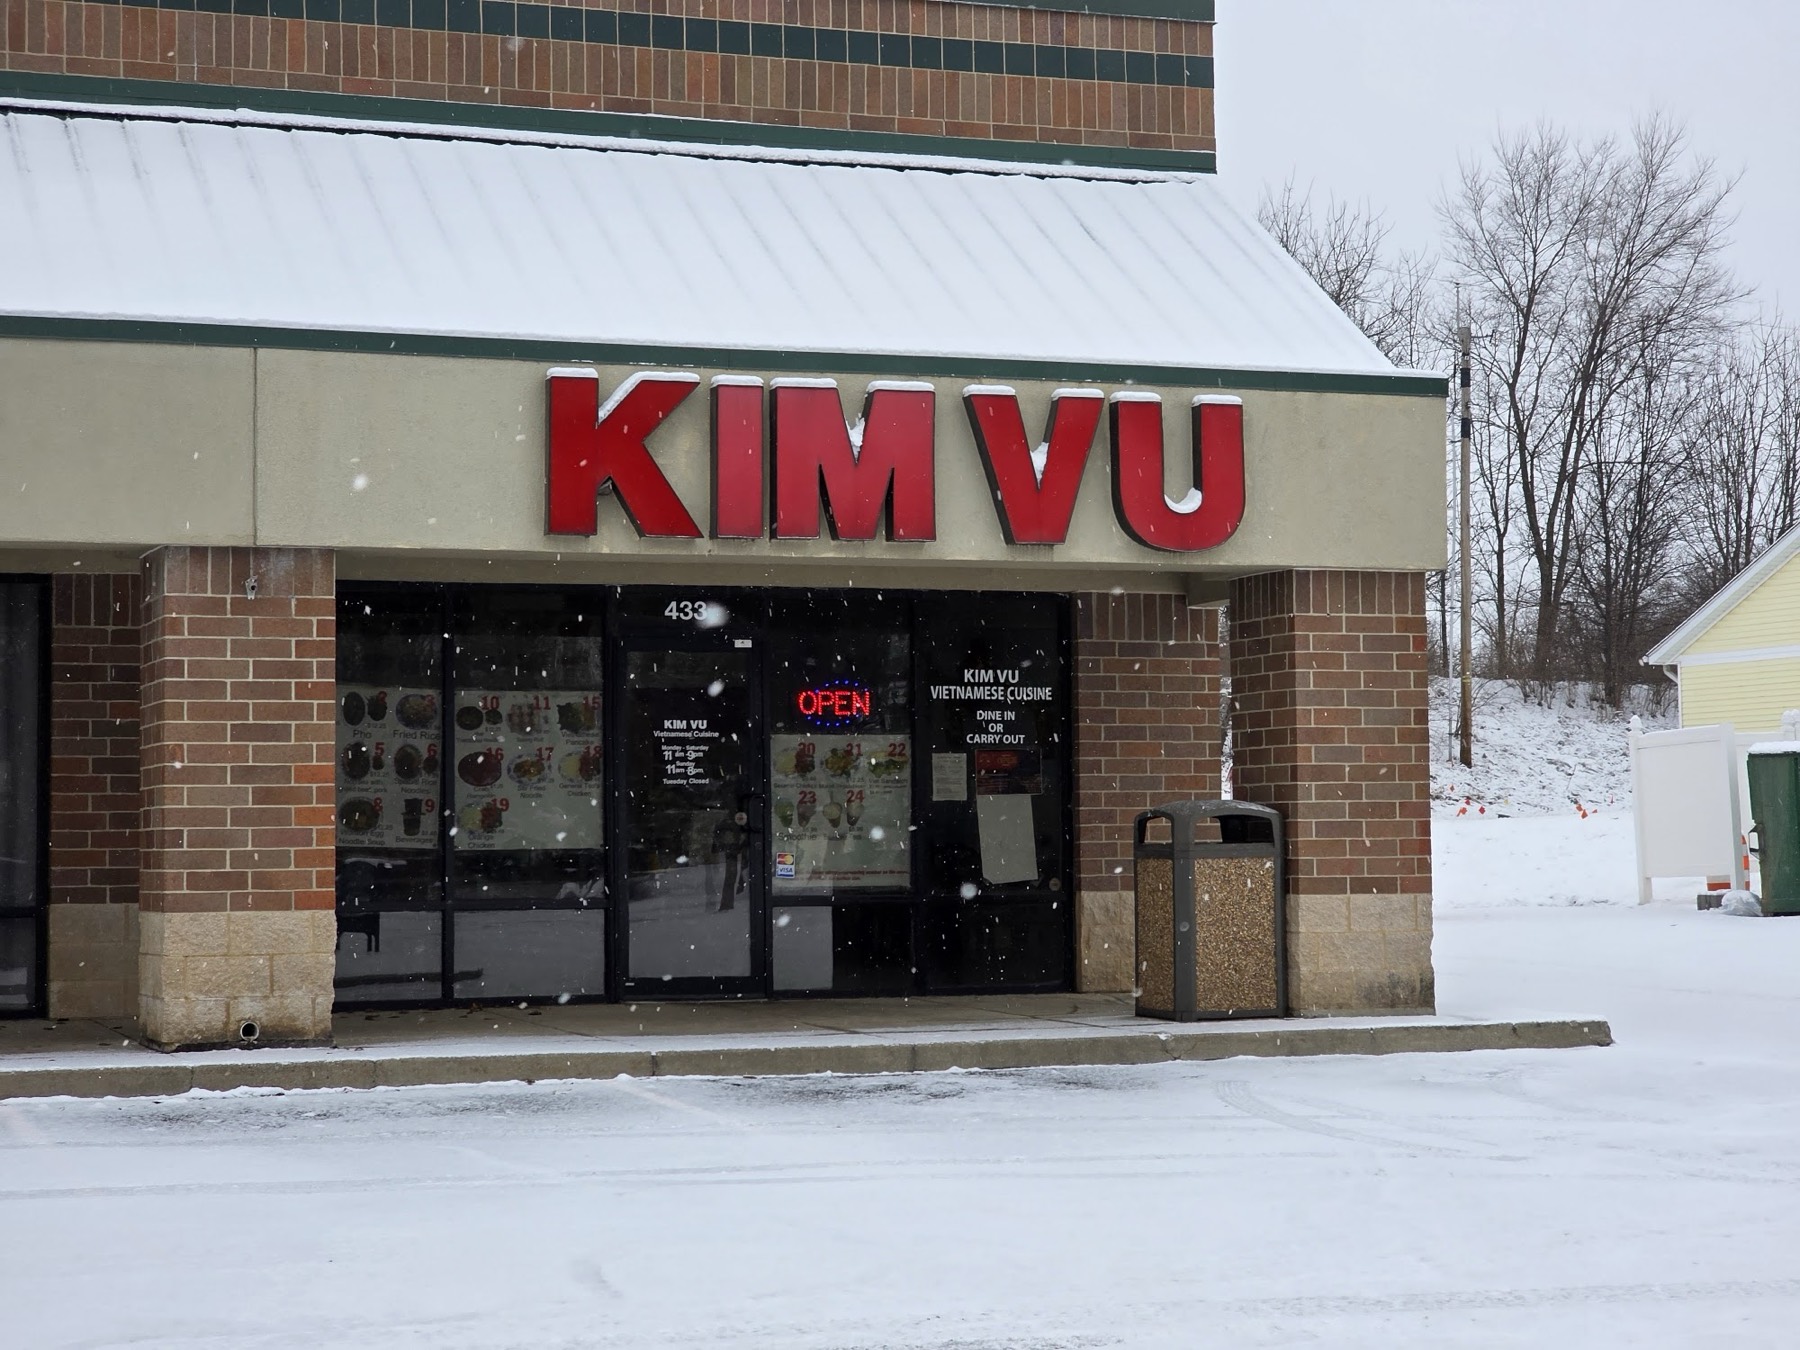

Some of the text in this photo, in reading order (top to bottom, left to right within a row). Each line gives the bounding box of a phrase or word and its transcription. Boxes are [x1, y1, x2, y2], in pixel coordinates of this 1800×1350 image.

[545, 370, 1246, 552] KIM VU
[664, 601, 707, 620] 433
[964, 669, 1019, 683] KIM VU
[930, 685, 1053, 701] VIETNAMESE CUISINE
[479, 695, 500, 711] 10
[532, 695, 552, 711] 11
[582, 695, 602, 711] 15
[799, 691, 870, 716] OPEN
[976, 710, 1016, 721] DINE IN
[663, 719, 708, 730] KIM VU
[988, 723, 1004, 733] OR
[352, 729, 373, 739] Pho
[392, 729, 441, 740] Fried Rice
[653, 730, 720, 738] Vietnamese Cuisine
[966, 734, 1026, 744] CARRY OUT
[374, 741, 385, 757] 5
[426, 743, 438, 758] 6
[484, 746, 505, 761] 16
[535, 746, 555, 762] 17
[663, 750, 673, 760] 11
[888, 743, 907, 758] 22
[675, 760, 696, 768] Sunday
[662, 778, 687, 786] Tuesday
[798, 790, 817, 805] 23
[846, 789, 864, 804] 24
[424, 798, 436, 814] 9
[491, 797, 510, 813] 19
